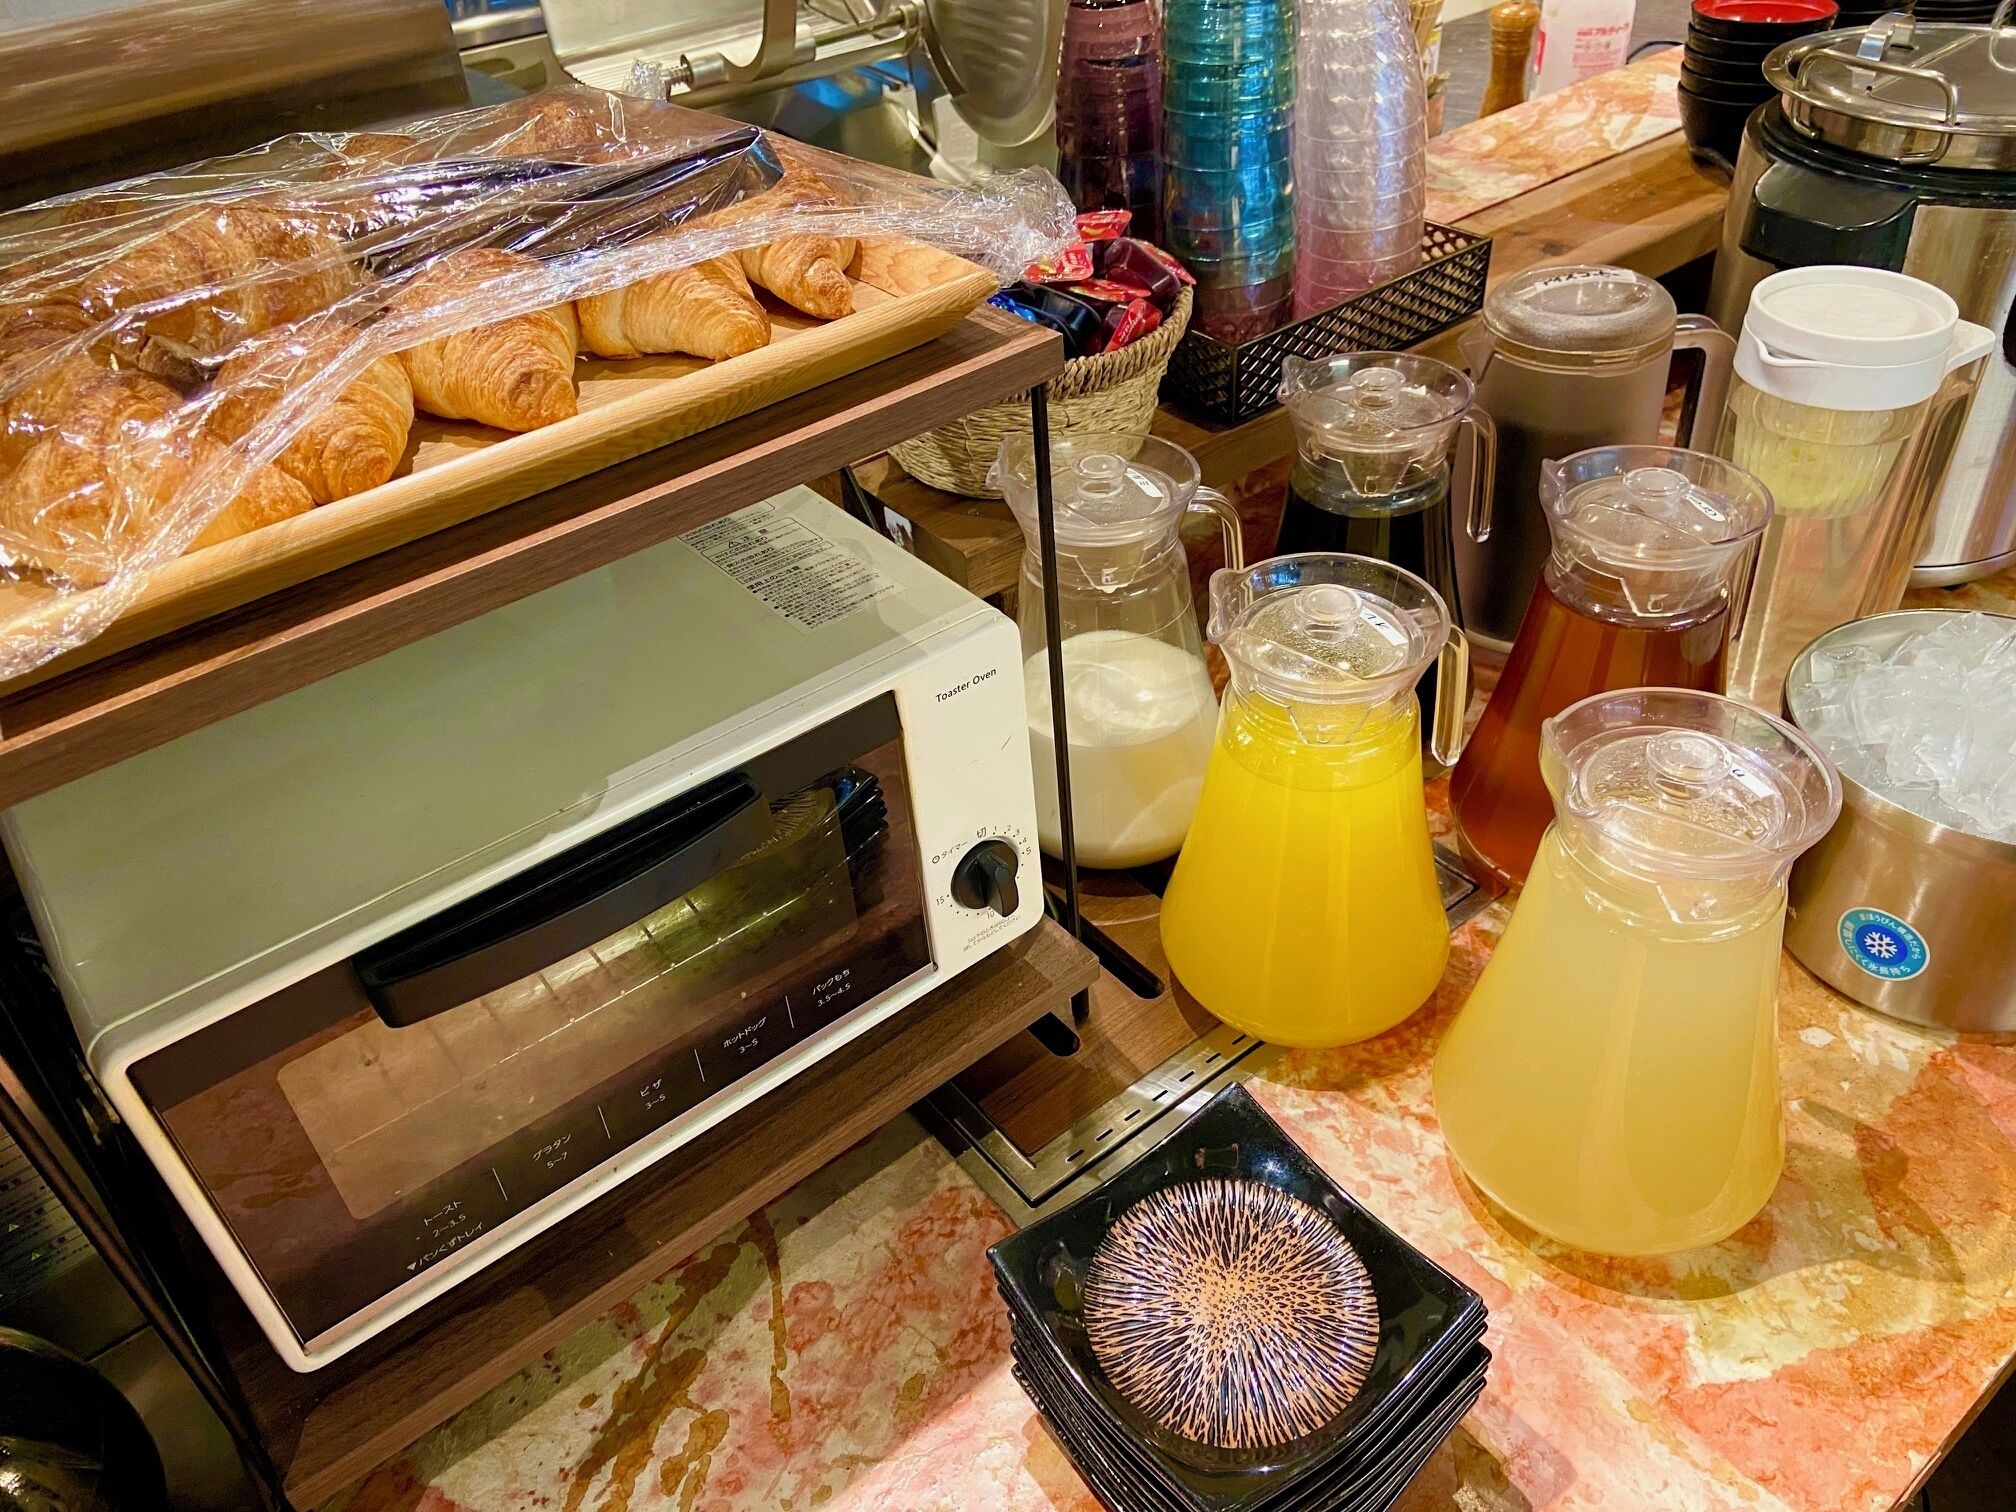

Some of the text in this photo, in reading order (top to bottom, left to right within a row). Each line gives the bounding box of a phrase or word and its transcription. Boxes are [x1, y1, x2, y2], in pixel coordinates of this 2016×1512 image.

[935, 668, 997, 702] Toaster Oven
[976, 827, 987, 838] 切
[941, 841, 968, 859] タイマー
[936, 895, 945, 906] 15
[986, 910, 995, 919] 10
[812, 968, 850, 996] パックもち
[722, 1016, 767, 1048] ホットドッグ
[532, 1134, 571, 1162] グラタン
[423, 1200, 462, 1227] トースト
[419, 1221, 483, 1266] パンくずトレイ
